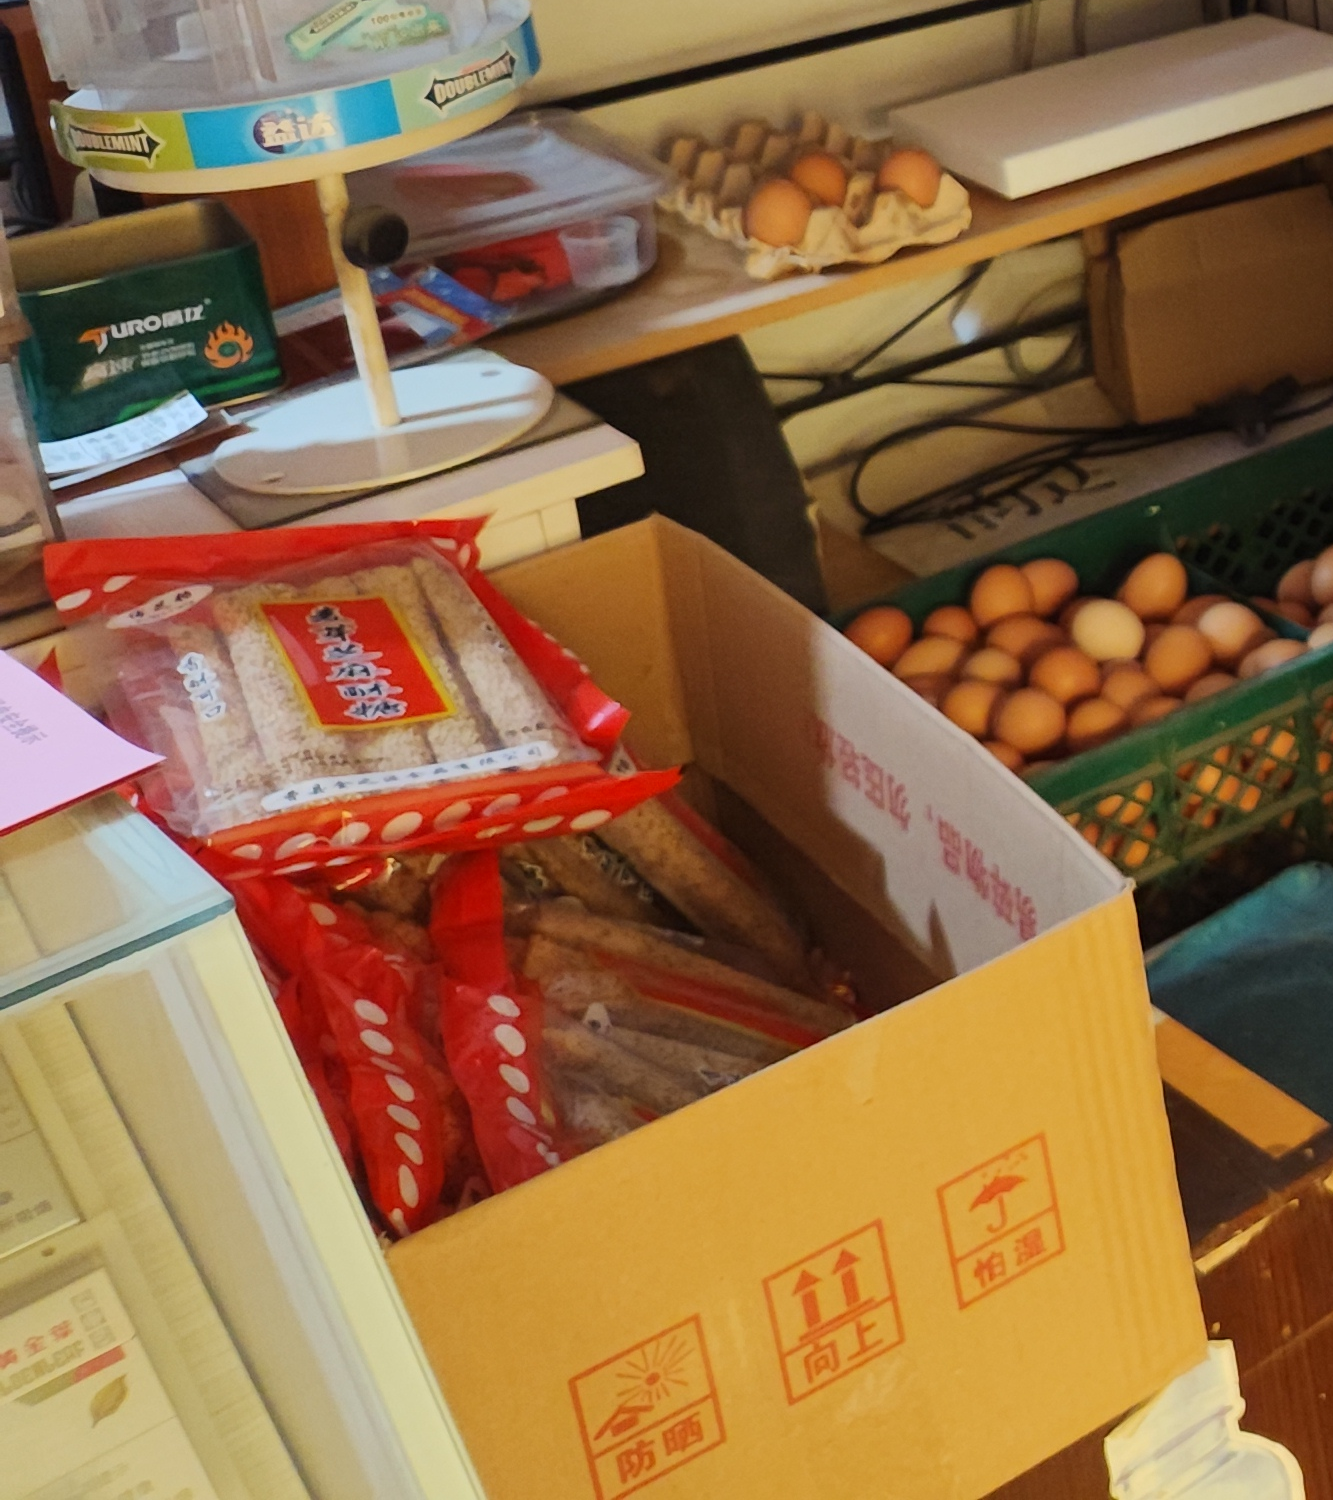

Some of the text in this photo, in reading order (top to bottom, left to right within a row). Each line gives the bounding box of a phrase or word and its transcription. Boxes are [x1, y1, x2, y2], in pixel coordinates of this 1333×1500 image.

[433, 53, 513, 105] DOUBLEMINT
[972, 1235, 1047, 1287] 怕湿
[803, 1318, 886, 1385] 向上
[617, 1411, 704, 1484] 防晒
